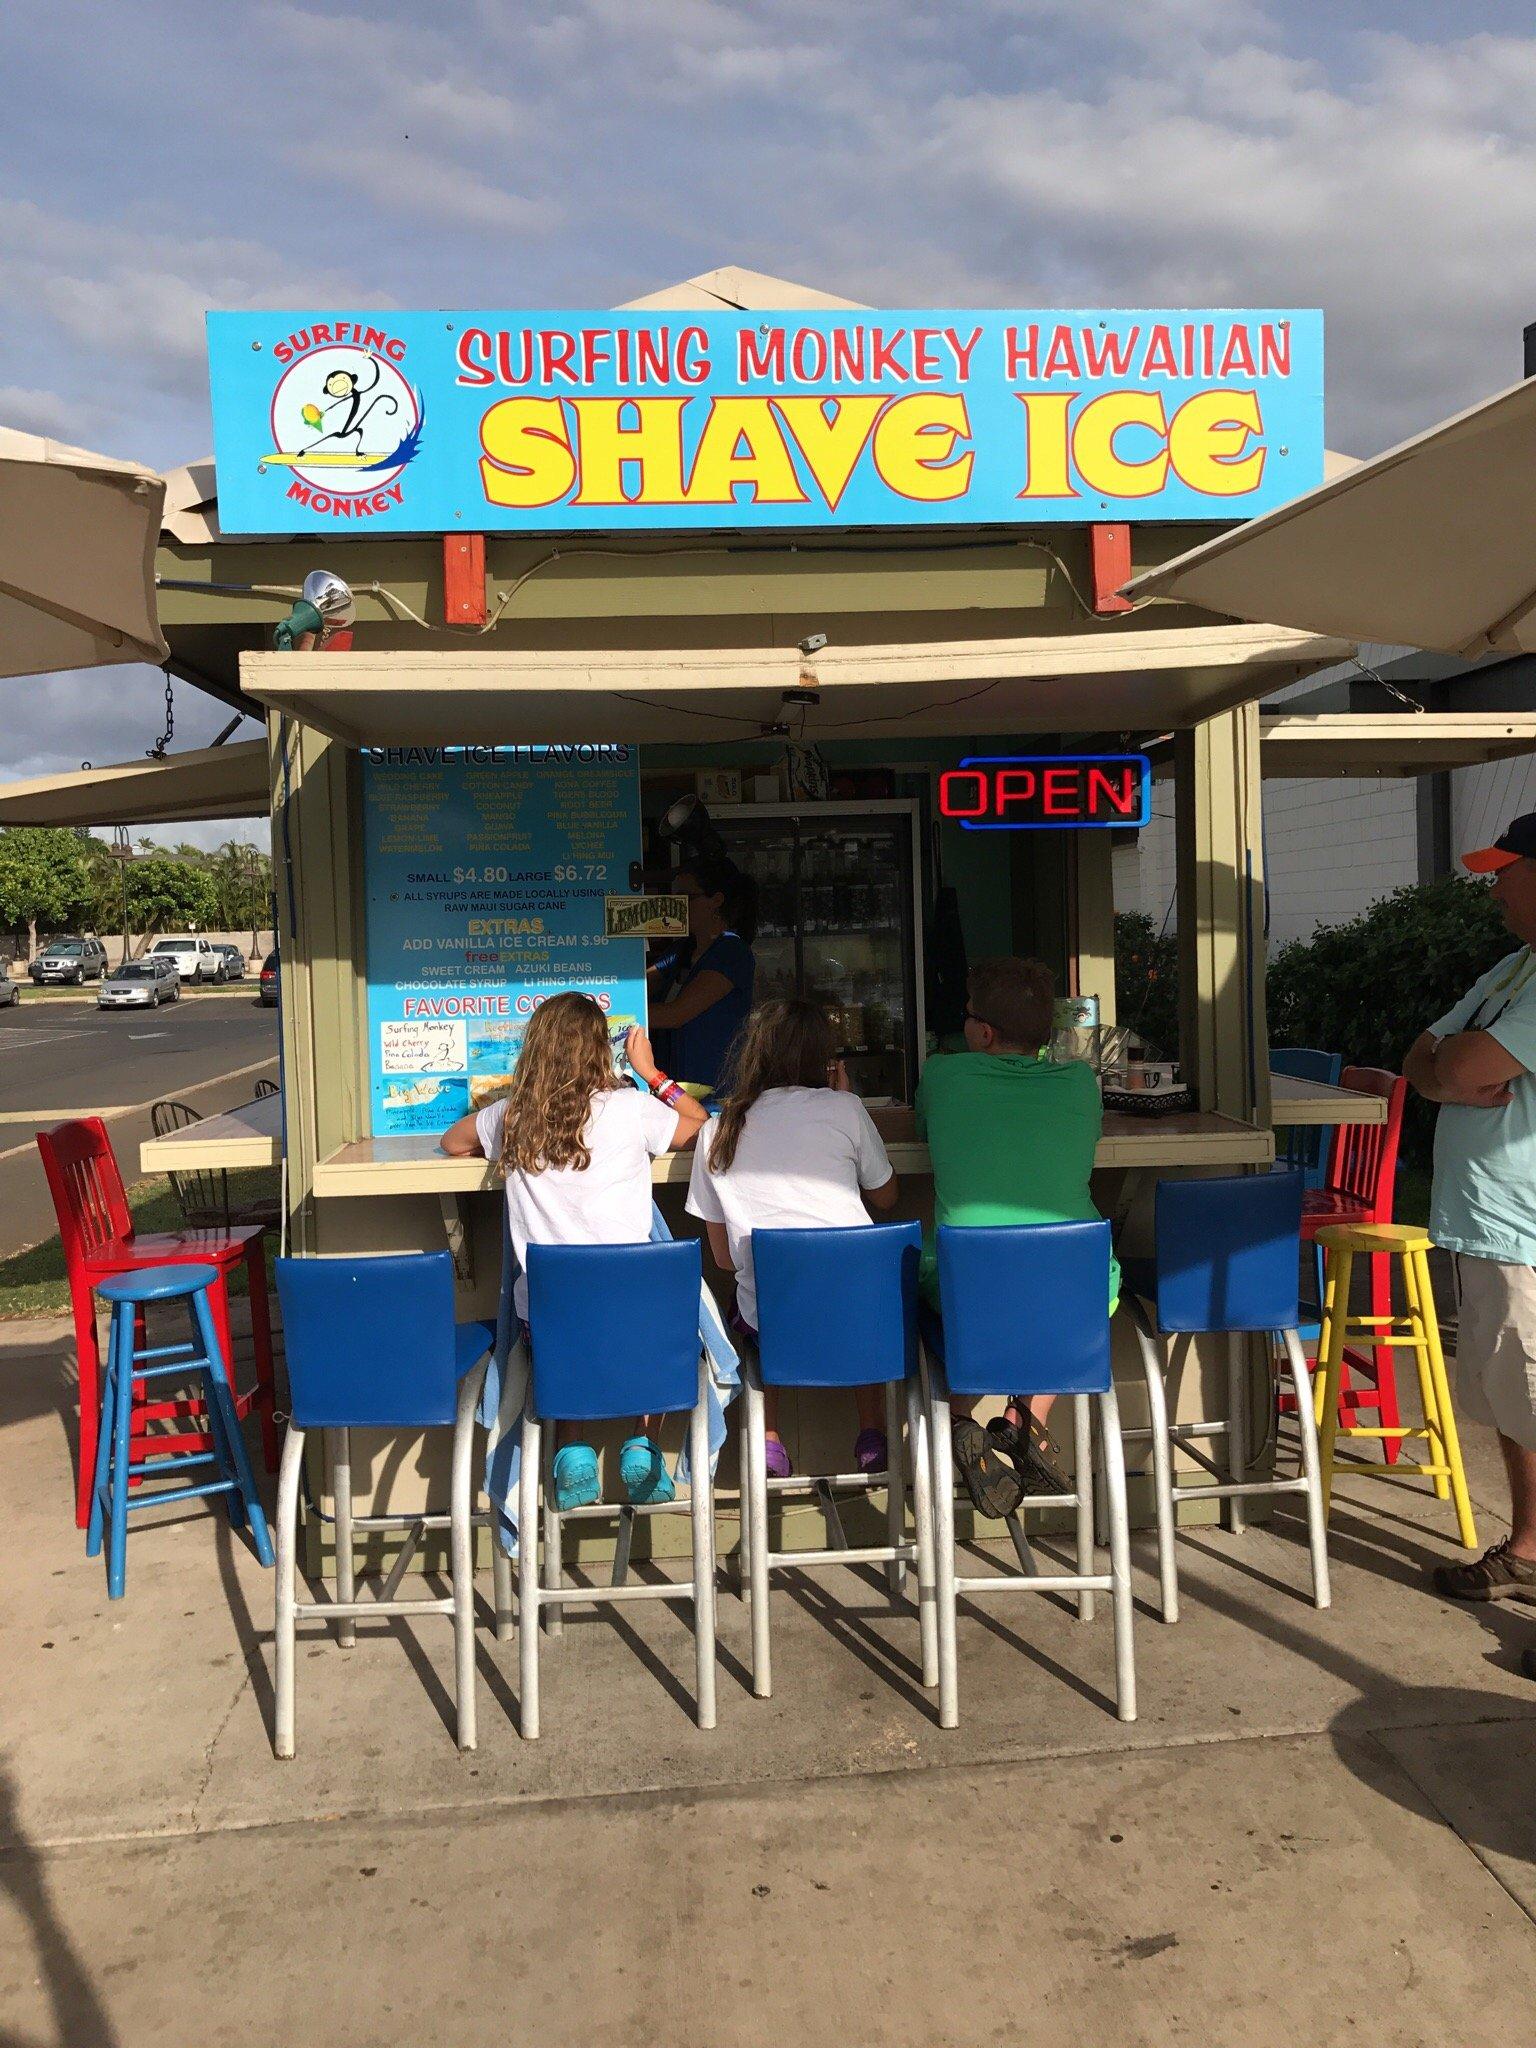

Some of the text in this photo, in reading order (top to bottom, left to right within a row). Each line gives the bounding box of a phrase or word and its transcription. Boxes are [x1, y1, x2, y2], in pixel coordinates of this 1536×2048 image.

[273, 322, 407, 365] SURFING
[455, 320, 1292, 387] SURFING MONKEY HAWAIIAN
[478, 389, 1268, 513] SHAVE ICE
[286, 482, 407, 518] MONKEY
[369, 744, 630, 765] SHAVE ICE FLAVORS
[939, 768, 1133, 817] OPEN
[407, 864, 607, 884] SMALL $4.80 LARGE $6.72
[404, 888, 605, 901] ALL SYRUPS ARE MADE LOCALLY USING
[444, 901, 567, 912] RAW MAUI SUGAR CANE
[468, 917, 545, 935] EXTRAS
[402, 938, 433, 951] ADD
[437, 937, 495, 949] VANILLA
[499, 936, 523, 948] ICE
[527, 935, 577, 947] CREAM
[465, 950, 550, 962] free EXTRAS
[421, 962, 592, 976] SWEET CREAM AZUKI BEANS
[395, 979, 467, 991] CHOCOLATE
[469, 978, 507, 989] SYRUP
[537, 976, 566, 987] HING
[568, 975, 619, 986] POWDER
[403, 995, 510, 1018] FAVORITE
[385, 1021, 455, 1037] Surfing Monkey
[402, 1039, 430, 1049] Cherry
